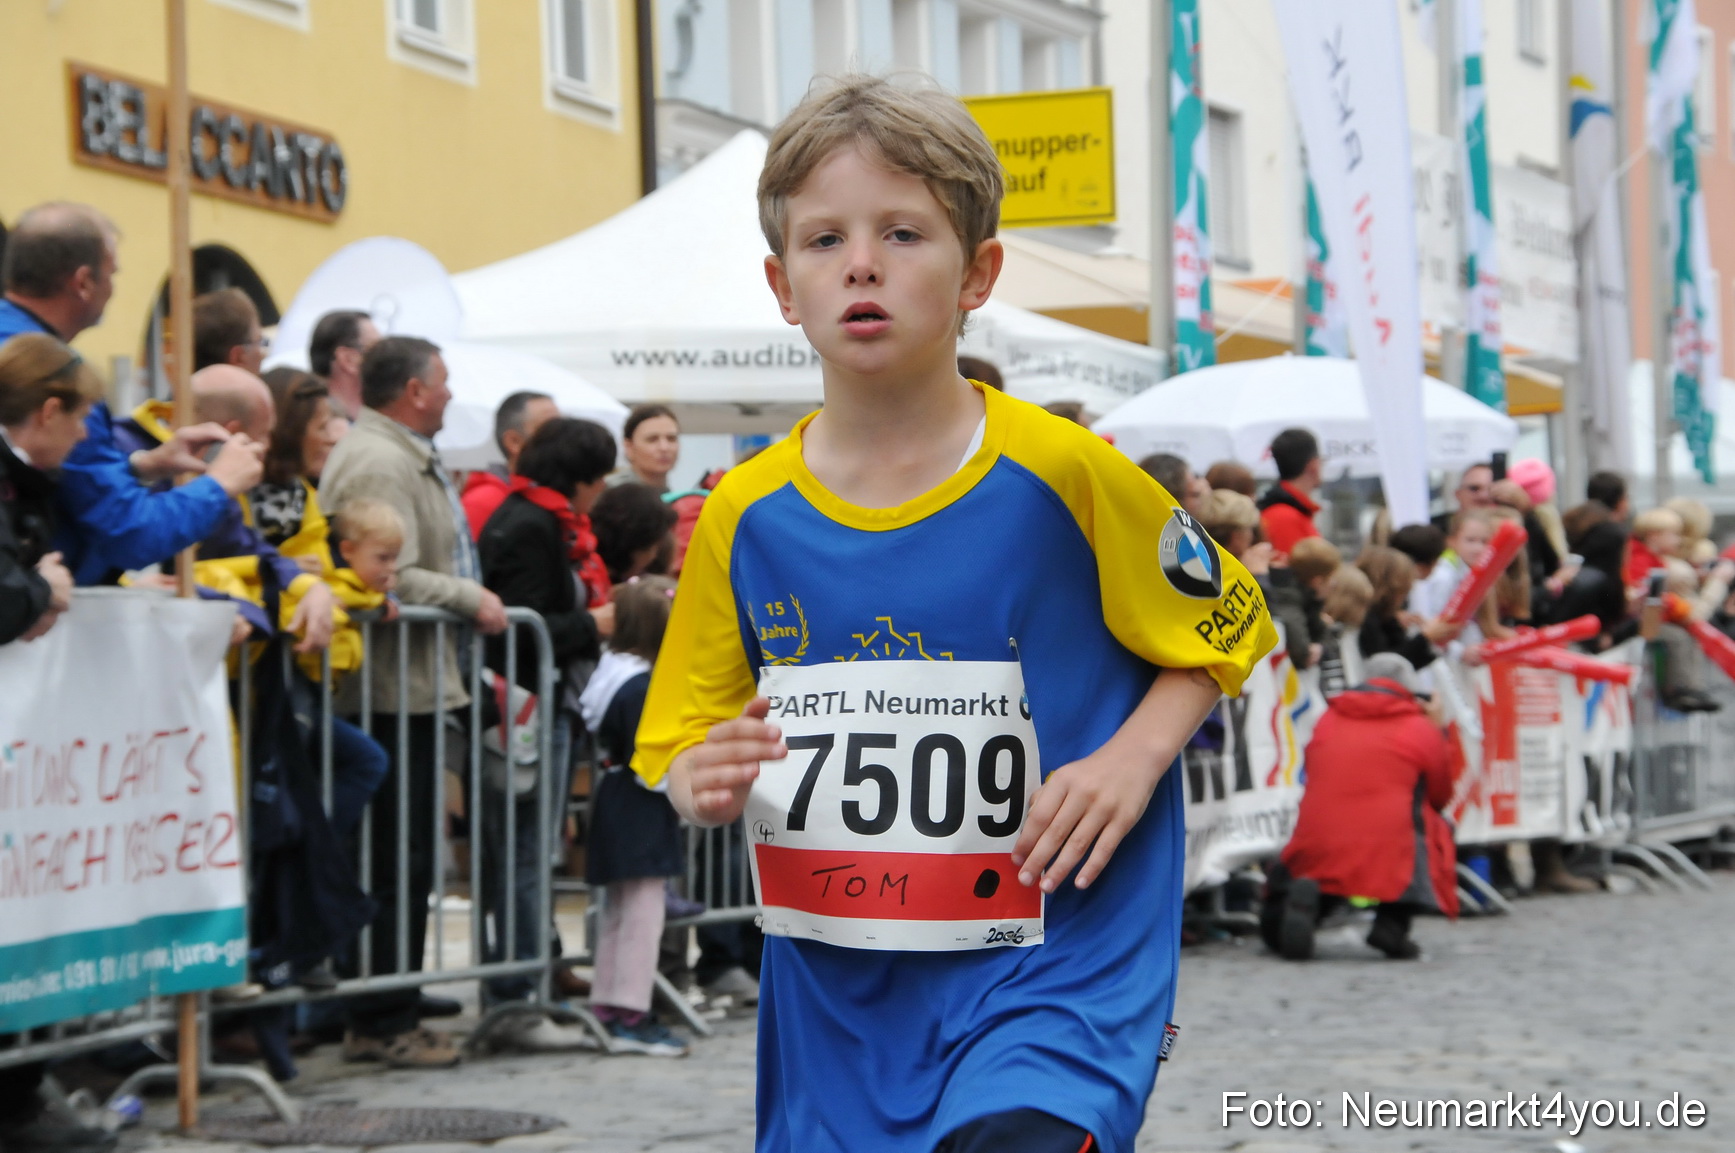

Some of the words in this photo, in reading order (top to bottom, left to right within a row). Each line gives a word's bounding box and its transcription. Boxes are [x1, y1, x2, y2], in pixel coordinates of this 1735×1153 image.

[764, 601, 786, 617] 15
[1195, 579, 1254, 644] PARTL
[760, 623, 799, 641] Jahre
[864, 689, 1009, 718] Neumarkt
[785, 732, 1027, 838] 7509
[811, 862, 910, 906] TOM
